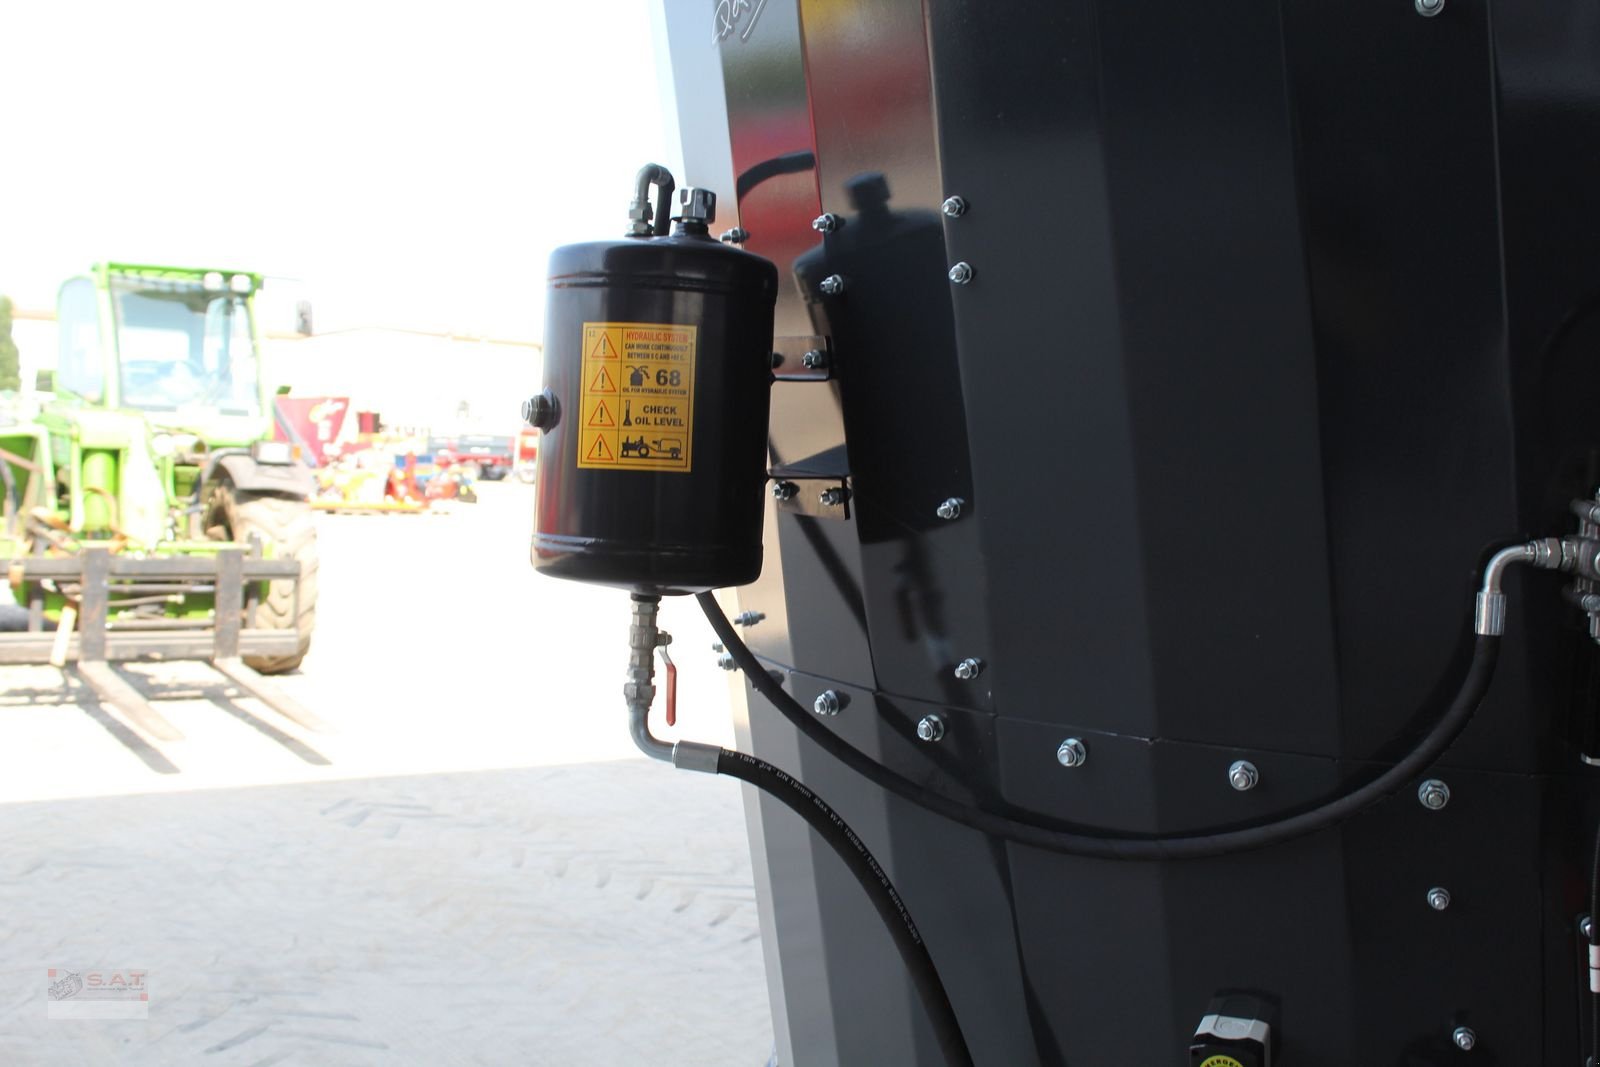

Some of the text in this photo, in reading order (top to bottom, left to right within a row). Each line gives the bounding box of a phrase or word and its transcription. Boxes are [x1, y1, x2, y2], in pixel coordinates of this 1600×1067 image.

[626, 331, 689, 343] HYDRAULIC SYSTEM
[656, 369, 681, 387] 68
[643, 405, 677, 415] CHECK
[634, 417, 684, 427] OIL LEVEL
